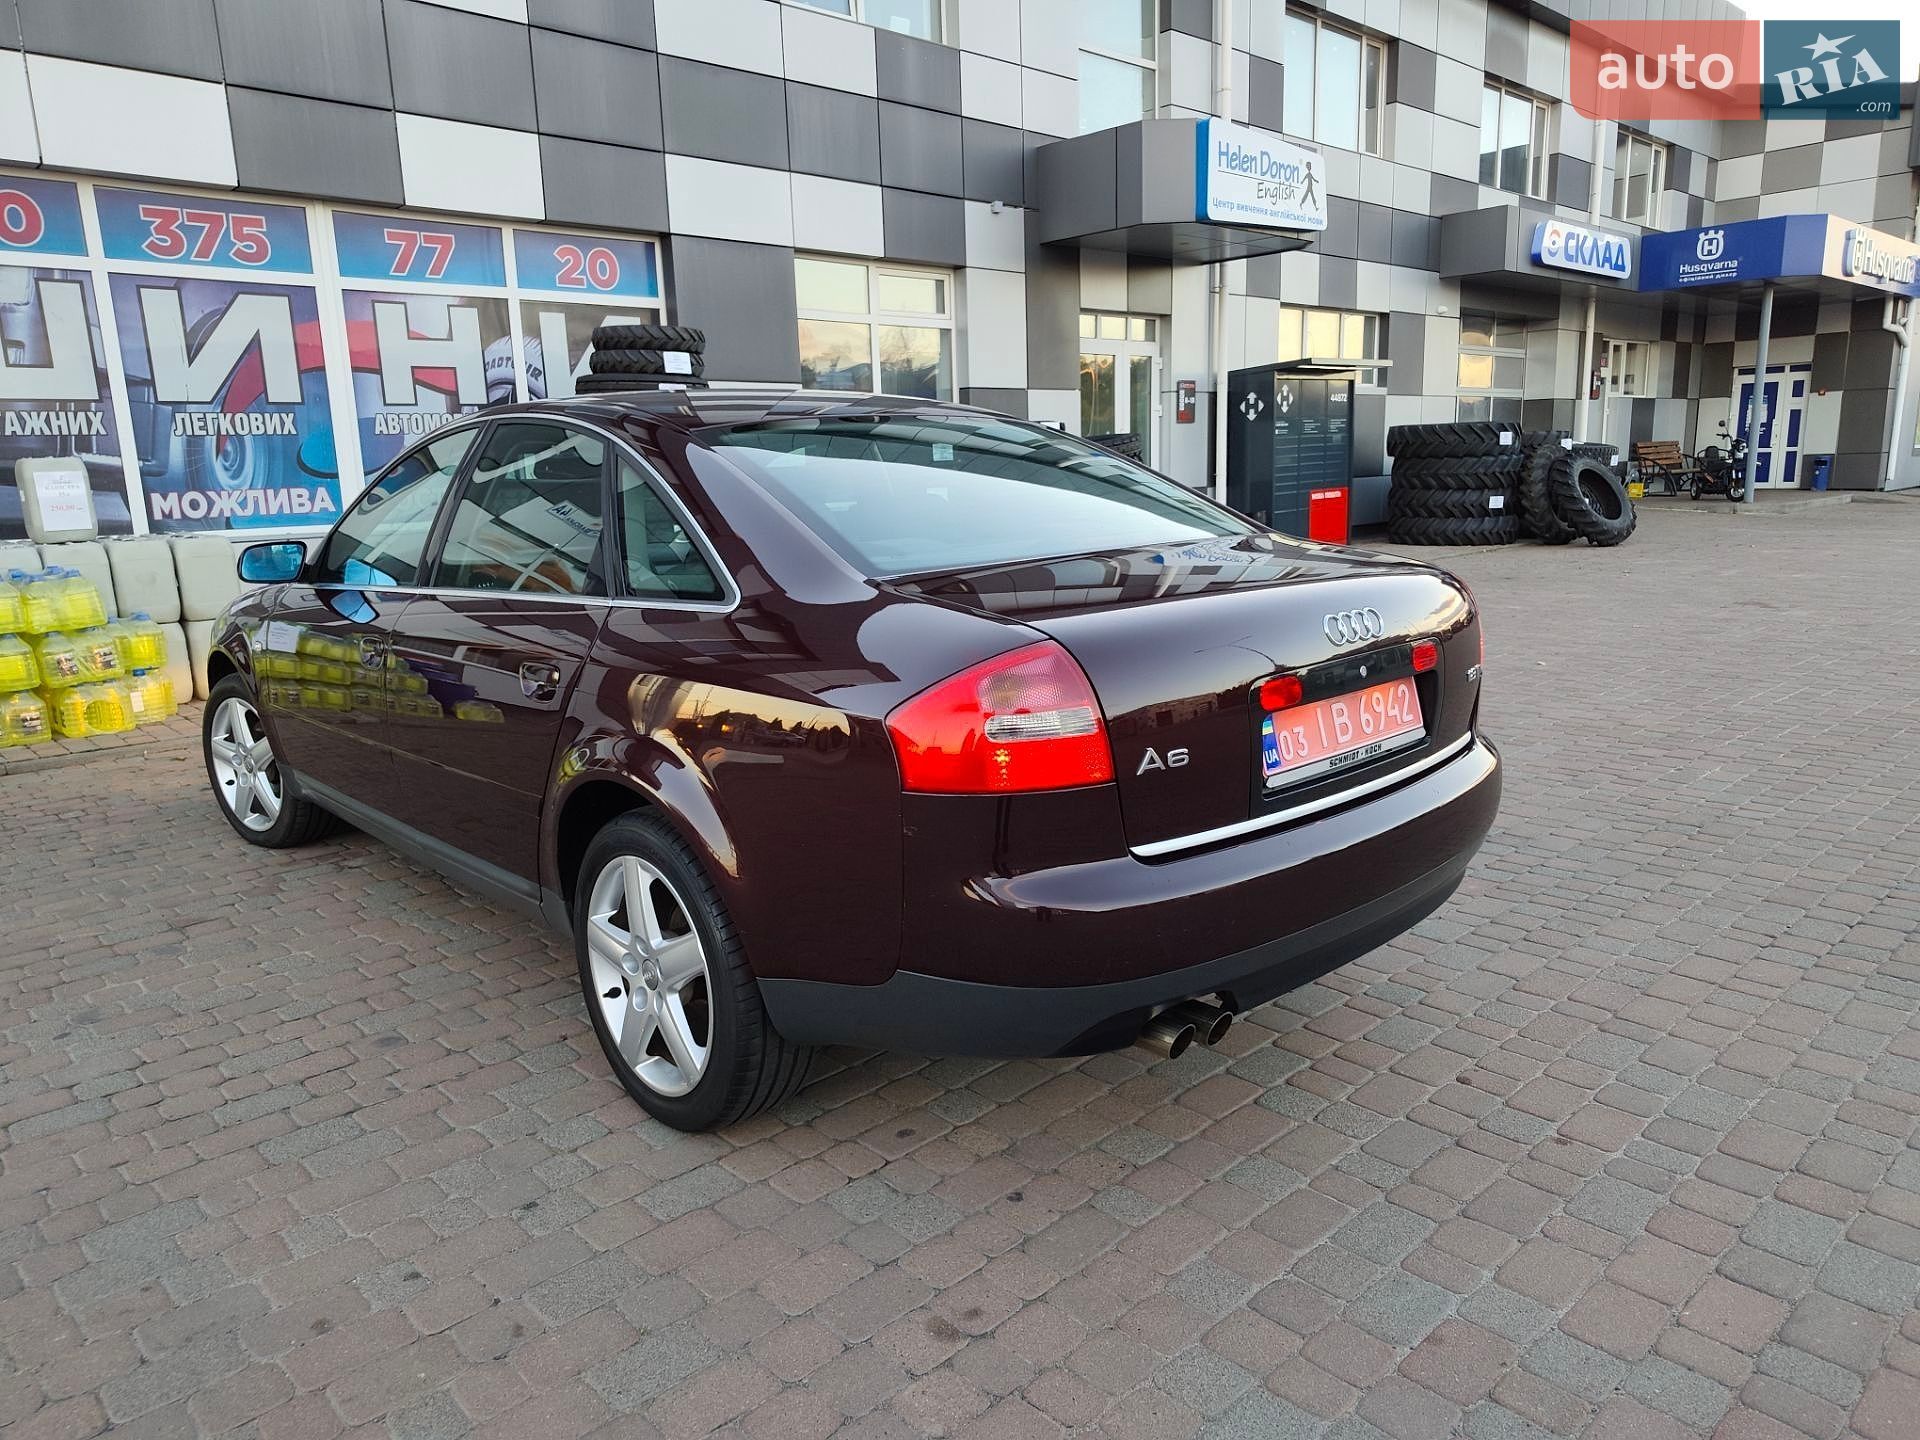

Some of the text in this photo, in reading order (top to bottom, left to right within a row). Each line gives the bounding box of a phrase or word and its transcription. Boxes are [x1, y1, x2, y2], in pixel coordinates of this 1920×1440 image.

[1218, 140, 1300, 184] Helen Doron
[1256, 181, 1296, 206] English
[1212, 197, 1324, 226] Центр вивчення англійської мови
[138, 204, 272, 265] 375
[383, 228, 455, 279] 77
[553, 244, 620, 291] 20
[1564, 231, 1626, 272] СКЛАД
[1863, 238, 1916, 284] Husqvarna
[1679, 260, 1738, 274] Husqvarna
[0, 410, 107, 436] АЖНИХ
[173, 411, 298, 437] ЛЕГКОВИХ
[151, 486, 336, 521] МОЖЛИВА
[1279, 726, 1309, 761] 03
[1360, 683, 1415, 735] 6942
[1136, 746, 1190, 776] A6
[1265, 748, 1280, 764] UA
[1329, 750, 1360, 768] SCHMIDT
